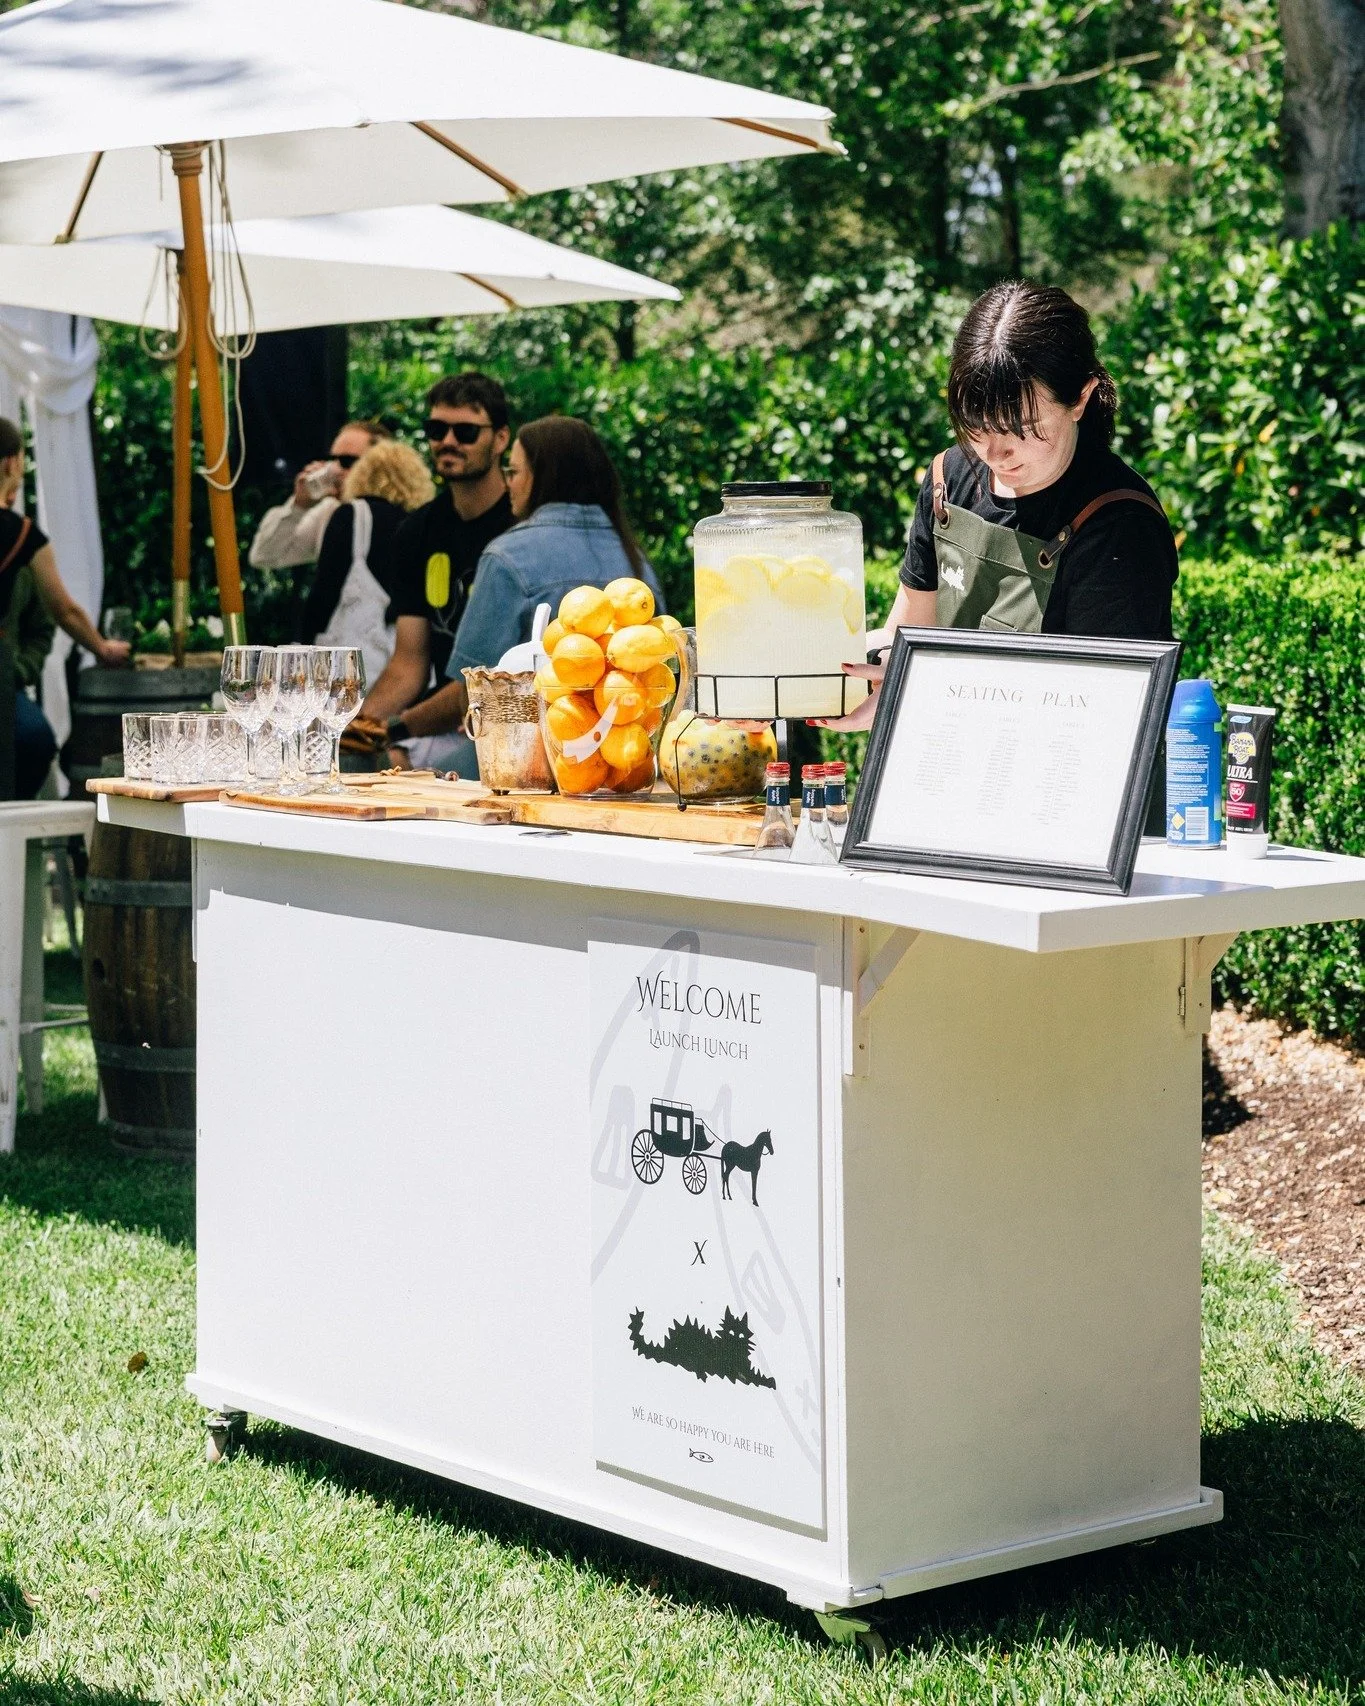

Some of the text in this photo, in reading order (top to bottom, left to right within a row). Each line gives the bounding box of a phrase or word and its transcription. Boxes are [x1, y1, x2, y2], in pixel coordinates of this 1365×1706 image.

[947, 685, 1089, 708] SEATING PLAN
[1227, 765, 1253, 779] ULTRA
[635, 970, 762, 1024] WELCOME
[649, 1028, 749, 1060] LAUNCH LUNCH
[691, 1239, 708, 1266] X
[632, 1406, 775, 1459] WE ARE SO HAPPY YOU ARE HERE
